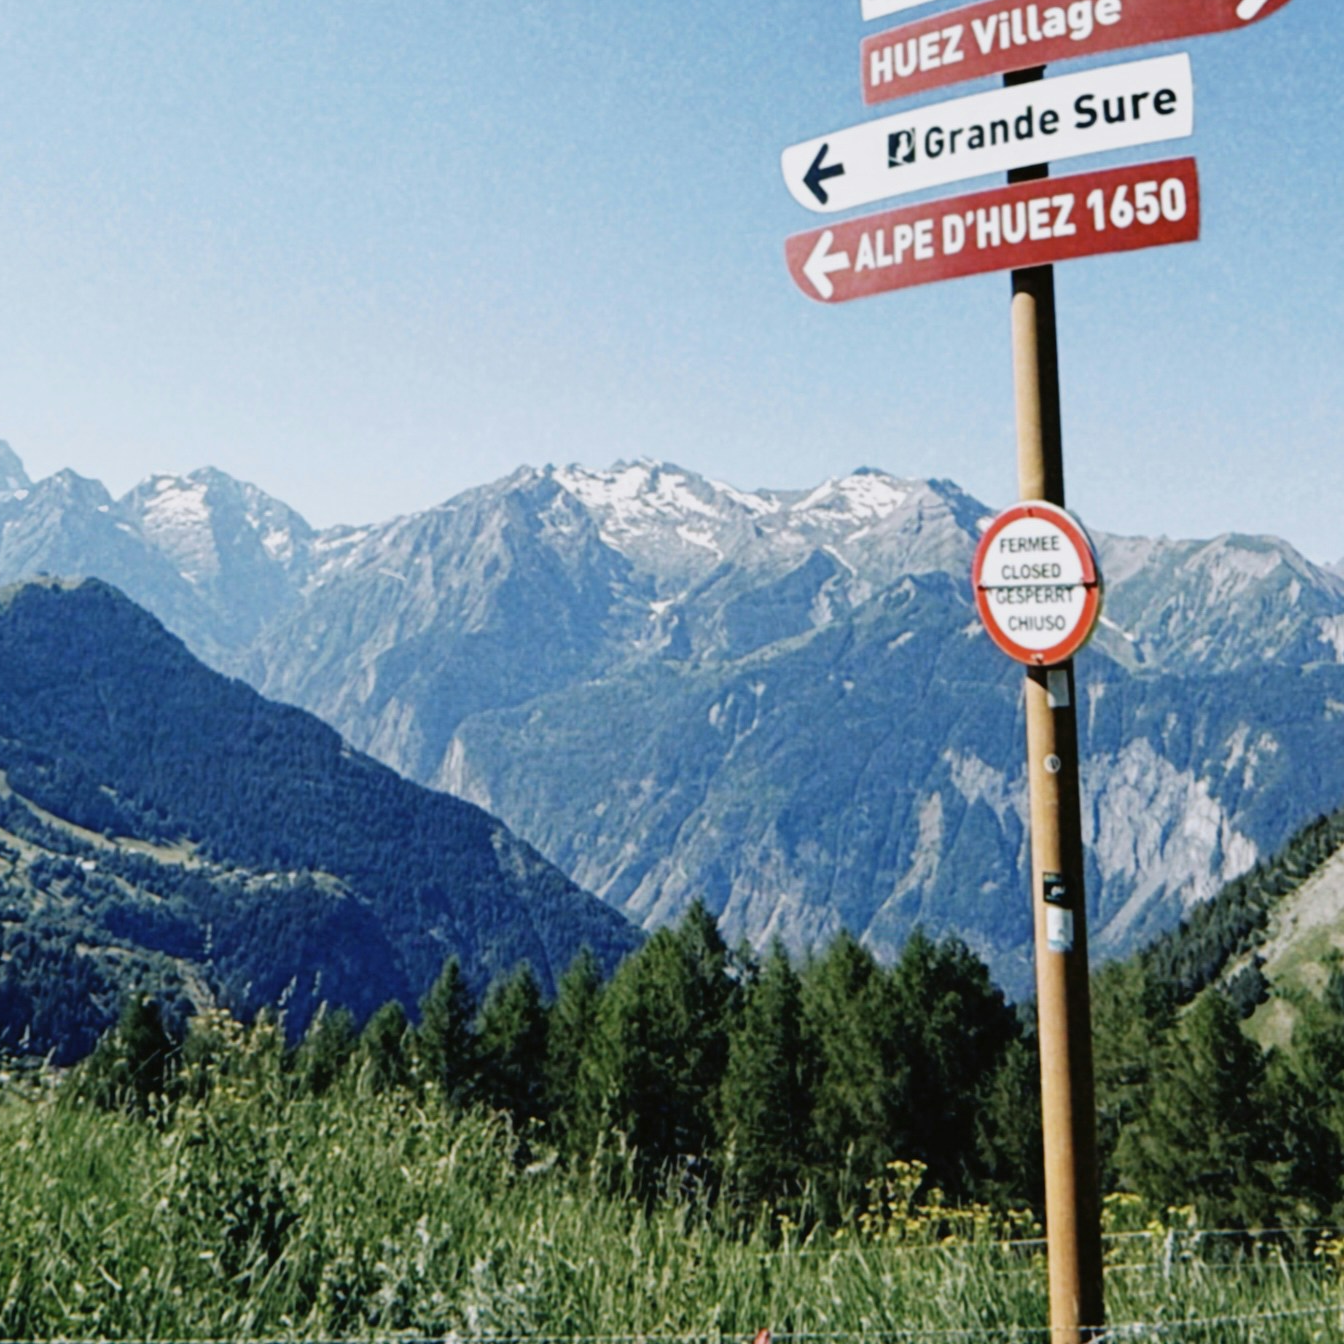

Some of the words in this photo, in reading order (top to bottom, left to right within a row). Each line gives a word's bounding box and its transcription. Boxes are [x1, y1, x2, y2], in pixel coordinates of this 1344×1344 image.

[870, 24, 964, 87] HUEZ
[924, 105, 1060, 158] Grande
[1074, 88, 1177, 129] Sure
[855, 218, 935, 272] ALPE
[942, 193, 1076, 255] D'HUEZ
[1087, 178, 1186, 231] 1650
[1000, 535, 1060, 553] FERMEE
[1001, 563, 1061, 580] CLOSED
[1008, 615, 1066, 631] CHIUSO
